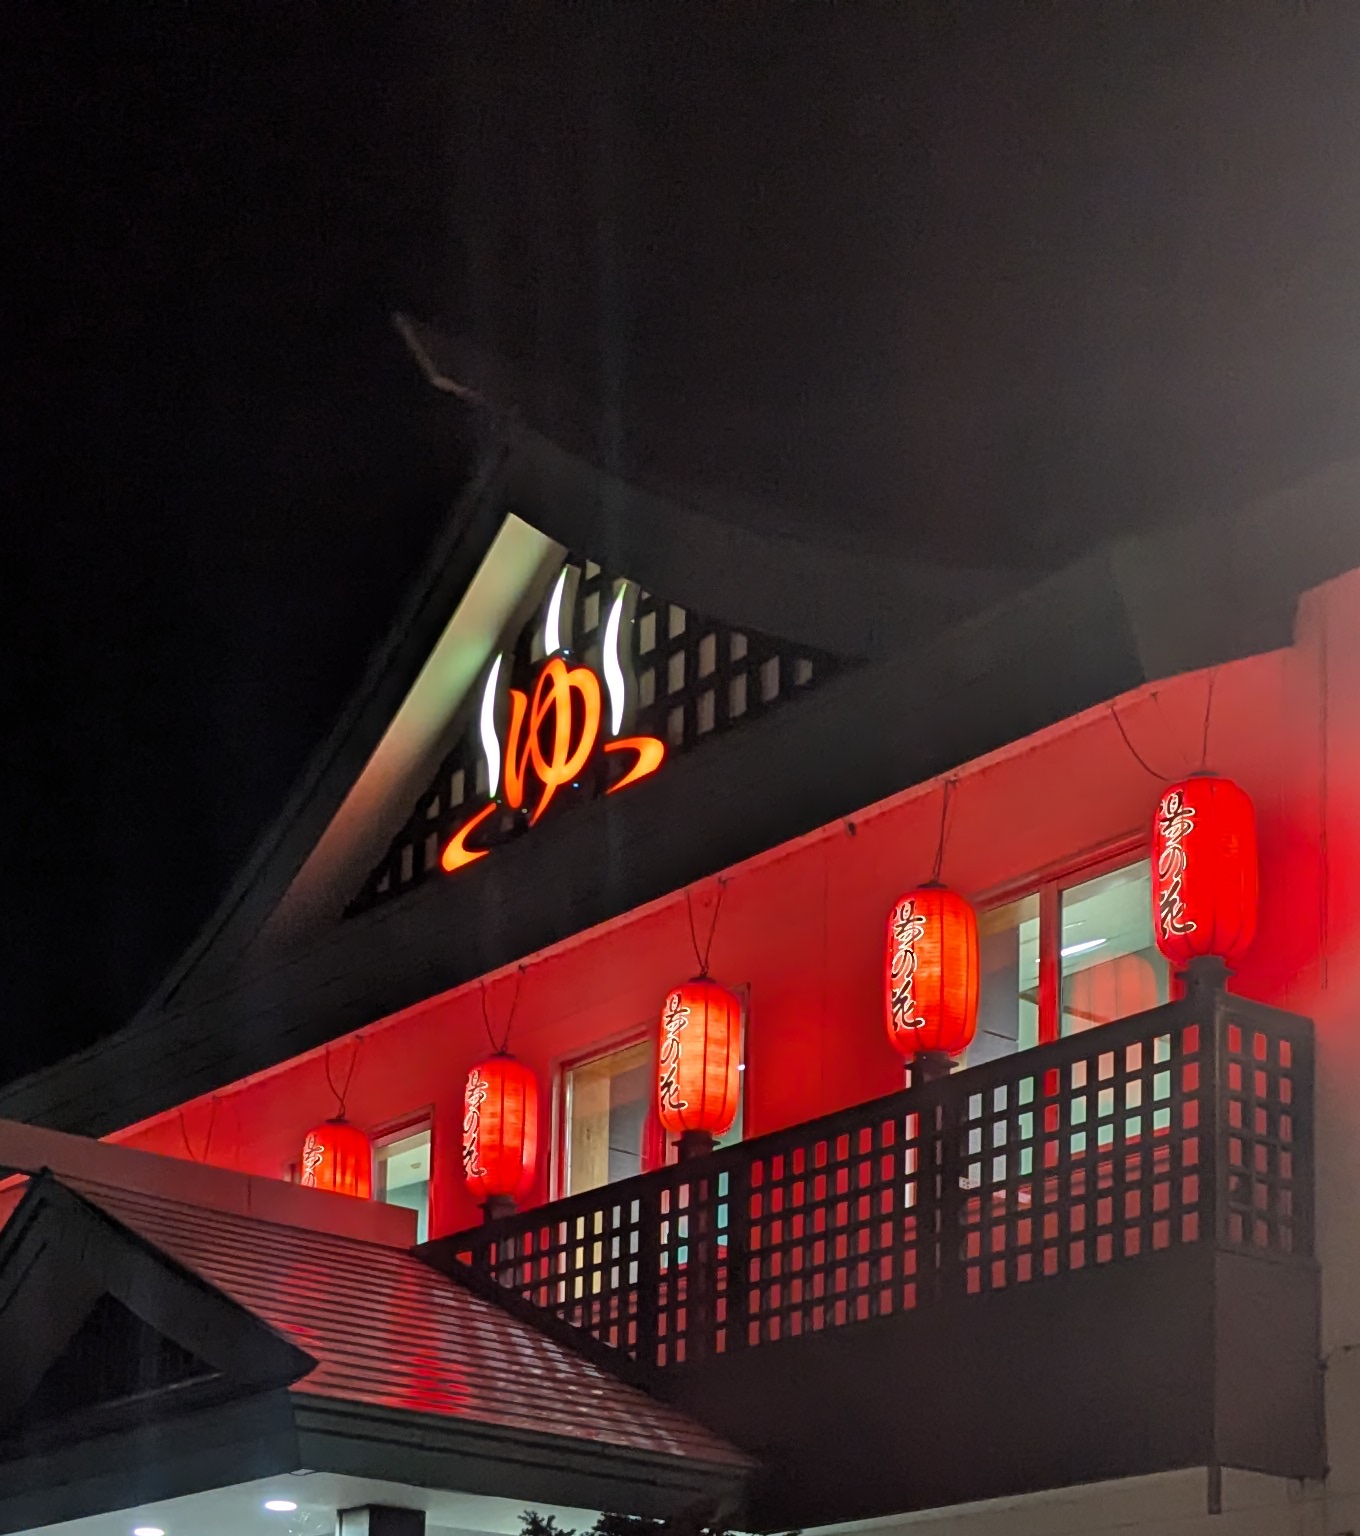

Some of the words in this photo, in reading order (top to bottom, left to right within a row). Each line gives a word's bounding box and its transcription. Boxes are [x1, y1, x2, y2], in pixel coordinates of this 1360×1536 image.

[1159, 789, 1197, 940] 湯の花
[892, 899, 926, 1032] 湯の花
[660, 992, 691, 1113] 湯の花
[462, 1067, 489, 1180] 湯の花
